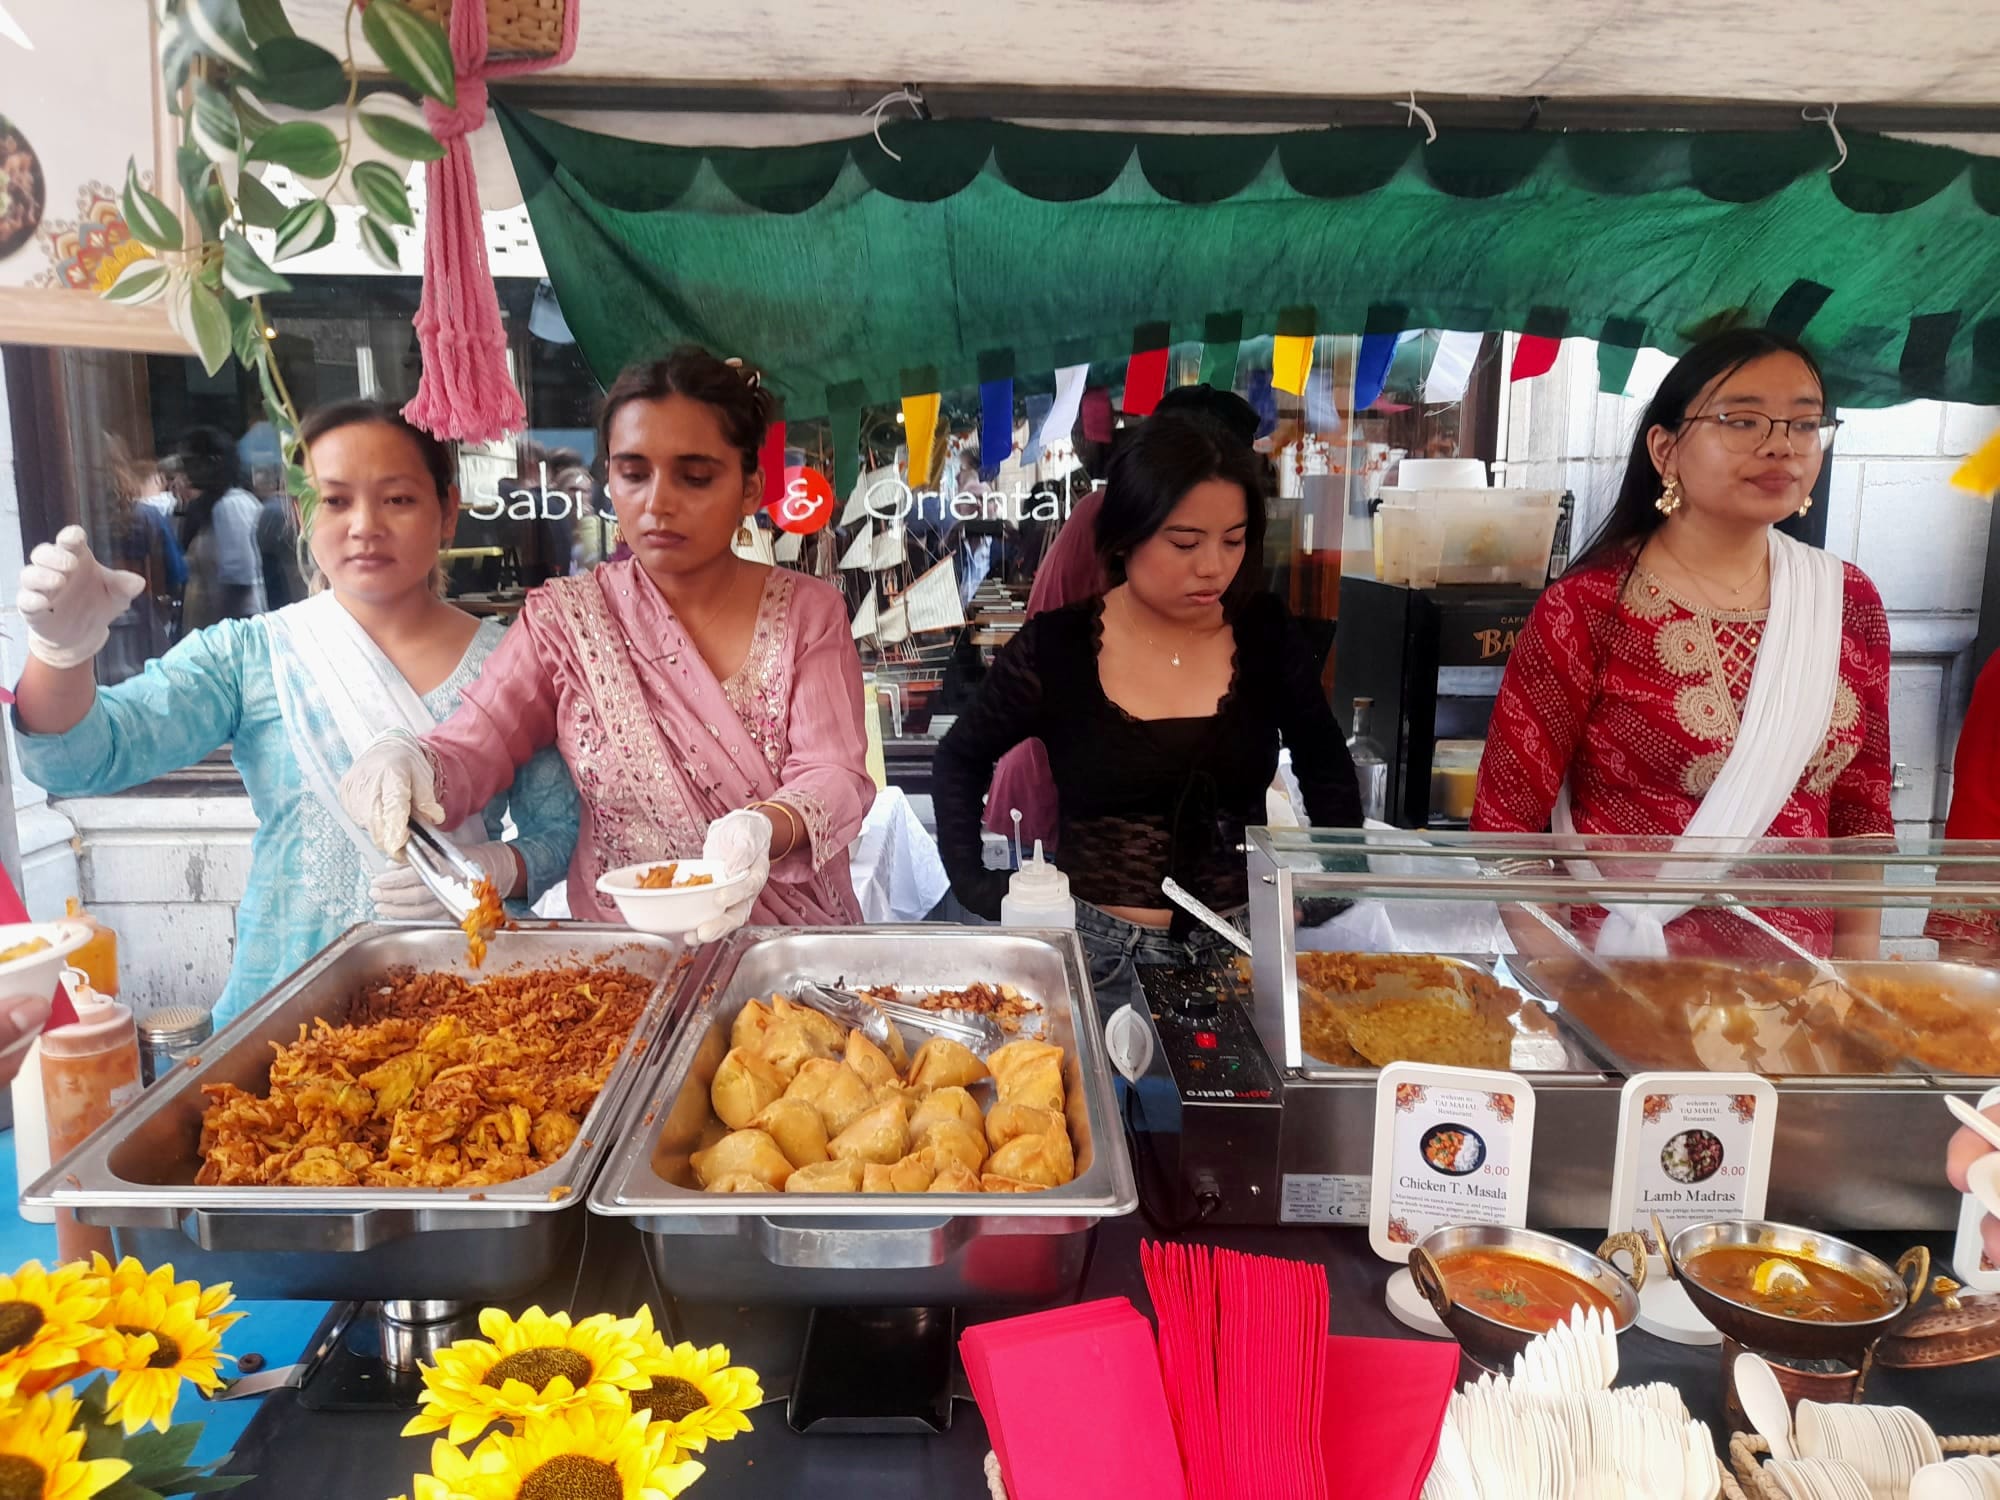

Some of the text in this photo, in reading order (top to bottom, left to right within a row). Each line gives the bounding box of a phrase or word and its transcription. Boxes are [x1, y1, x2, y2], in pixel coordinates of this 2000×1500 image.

[468, 460, 584, 521] Sabi
[782, 477, 824, 521] &
[864, 461, 1072, 521] Oriental
[1399, 1176, 1508, 1200] Chicken T. Masala
[1643, 1189, 1736, 1202] Lamb Madras
